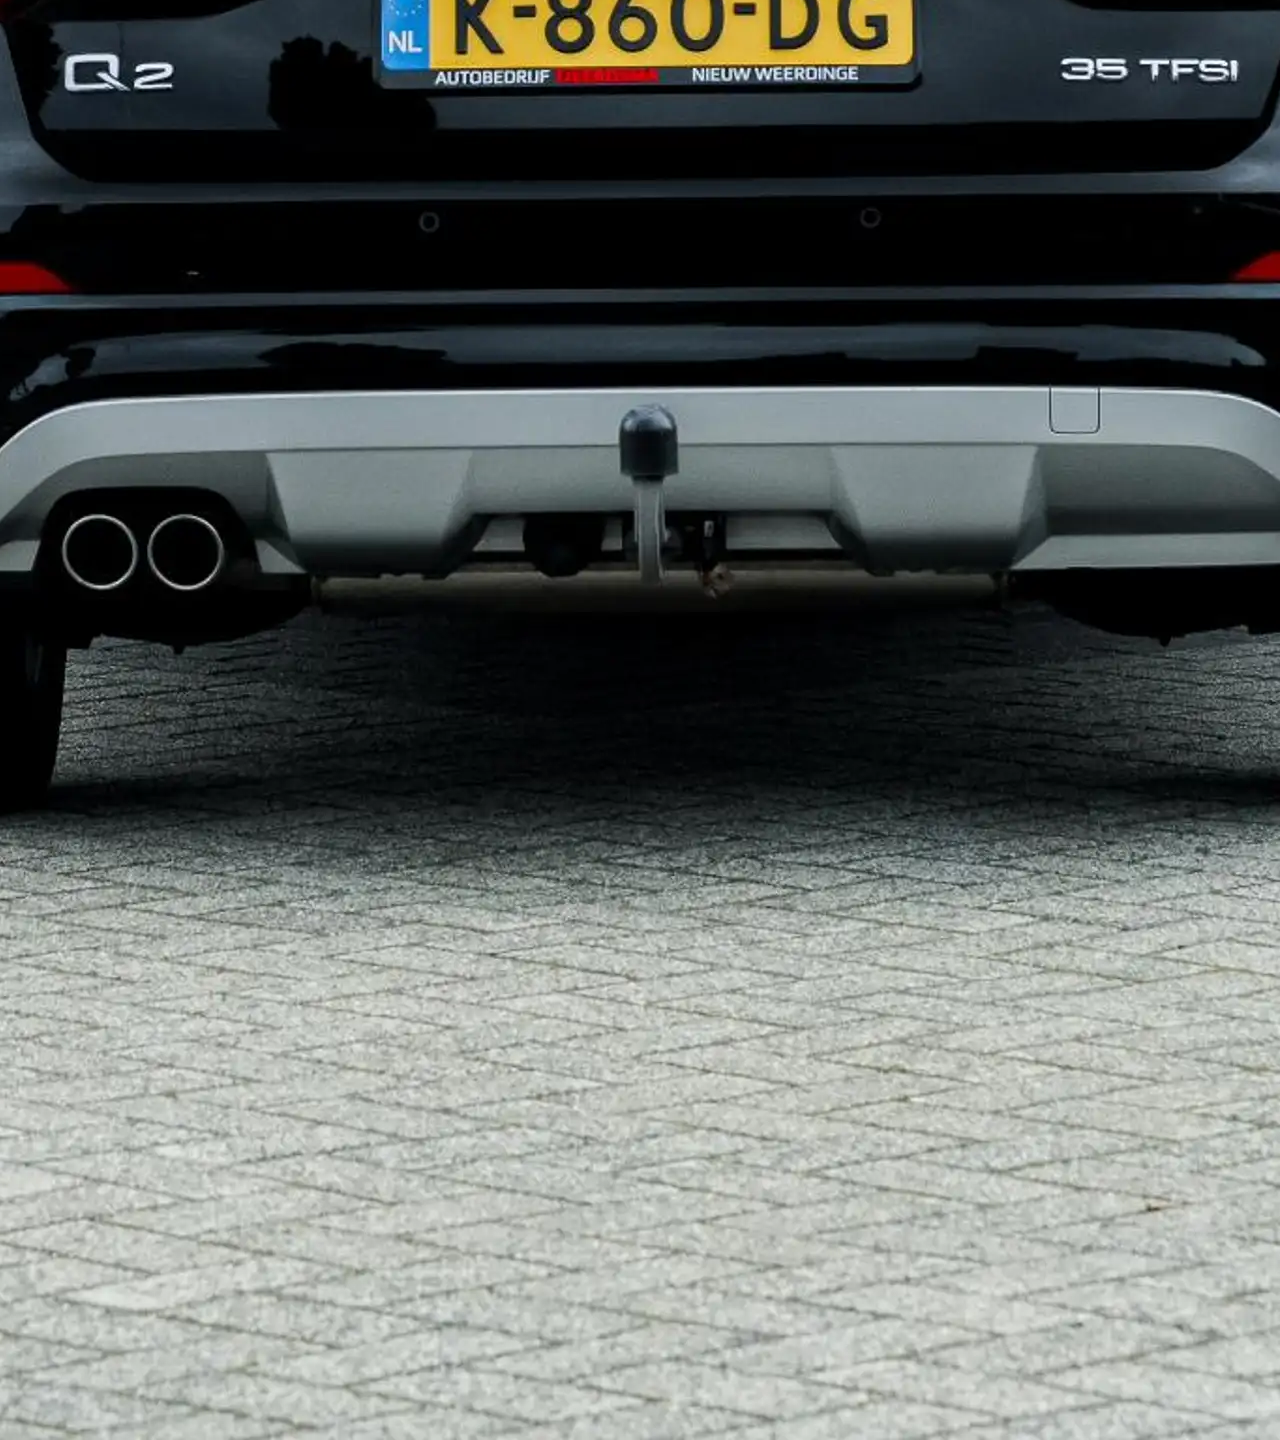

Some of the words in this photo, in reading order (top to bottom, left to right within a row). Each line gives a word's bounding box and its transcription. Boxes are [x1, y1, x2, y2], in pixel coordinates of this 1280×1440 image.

[387, 30, 422, 54] NL
[64, 53, 174, 92] Q2
[691, 66, 753, 84] NIEUW
[754, 65, 859, 84] WEERDINGE
[1060, 57, 1129, 81] 35
[1139, 59, 1240, 83] TFSI
